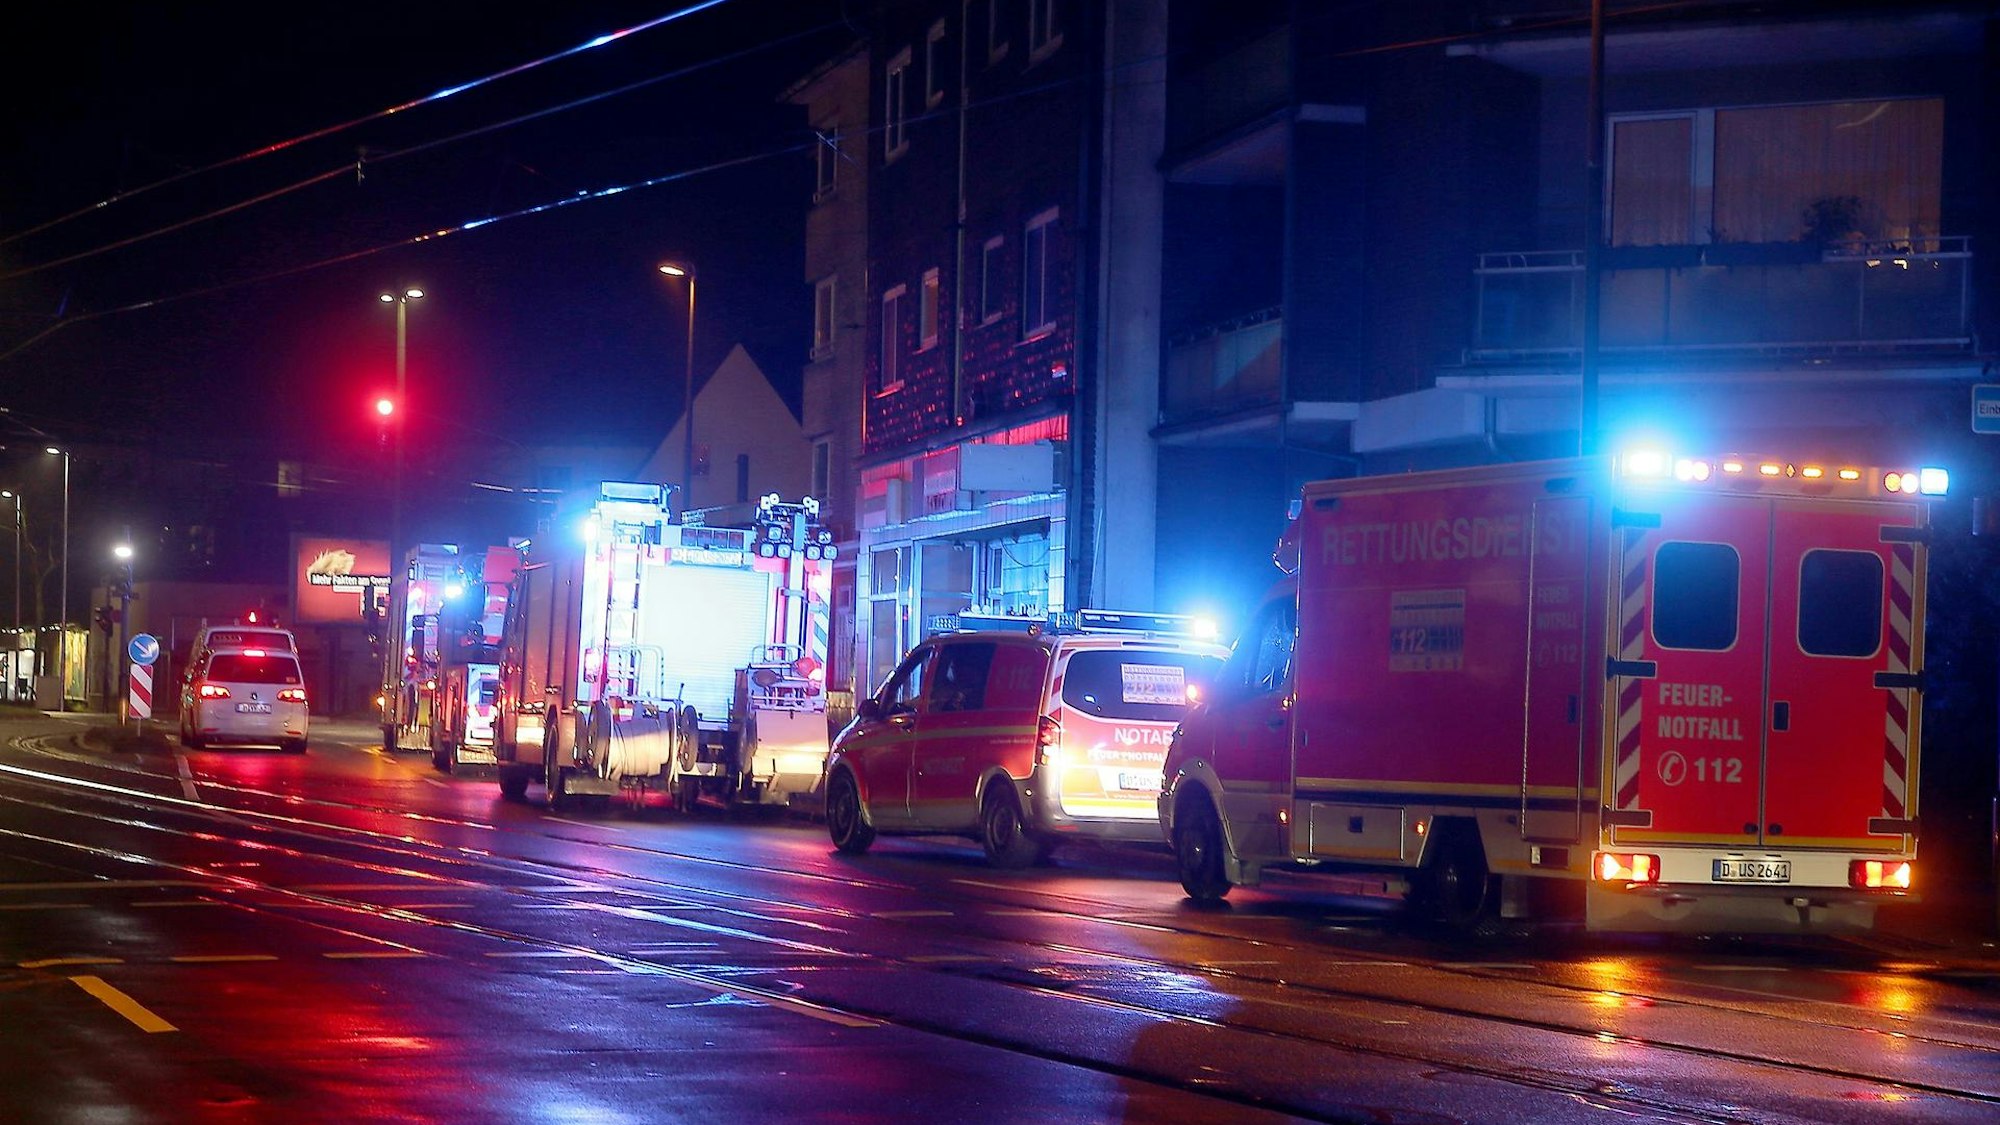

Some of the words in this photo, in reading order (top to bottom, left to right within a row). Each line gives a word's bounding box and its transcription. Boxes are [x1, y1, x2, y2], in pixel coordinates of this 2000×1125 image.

[1322, 513, 1577, 566] RETTUNGSDIENST
[1659, 683, 1733, 708] FEUER-
[1658, 716, 1743, 741] NOTFALL
[1694, 758, 1742, 783] 112
